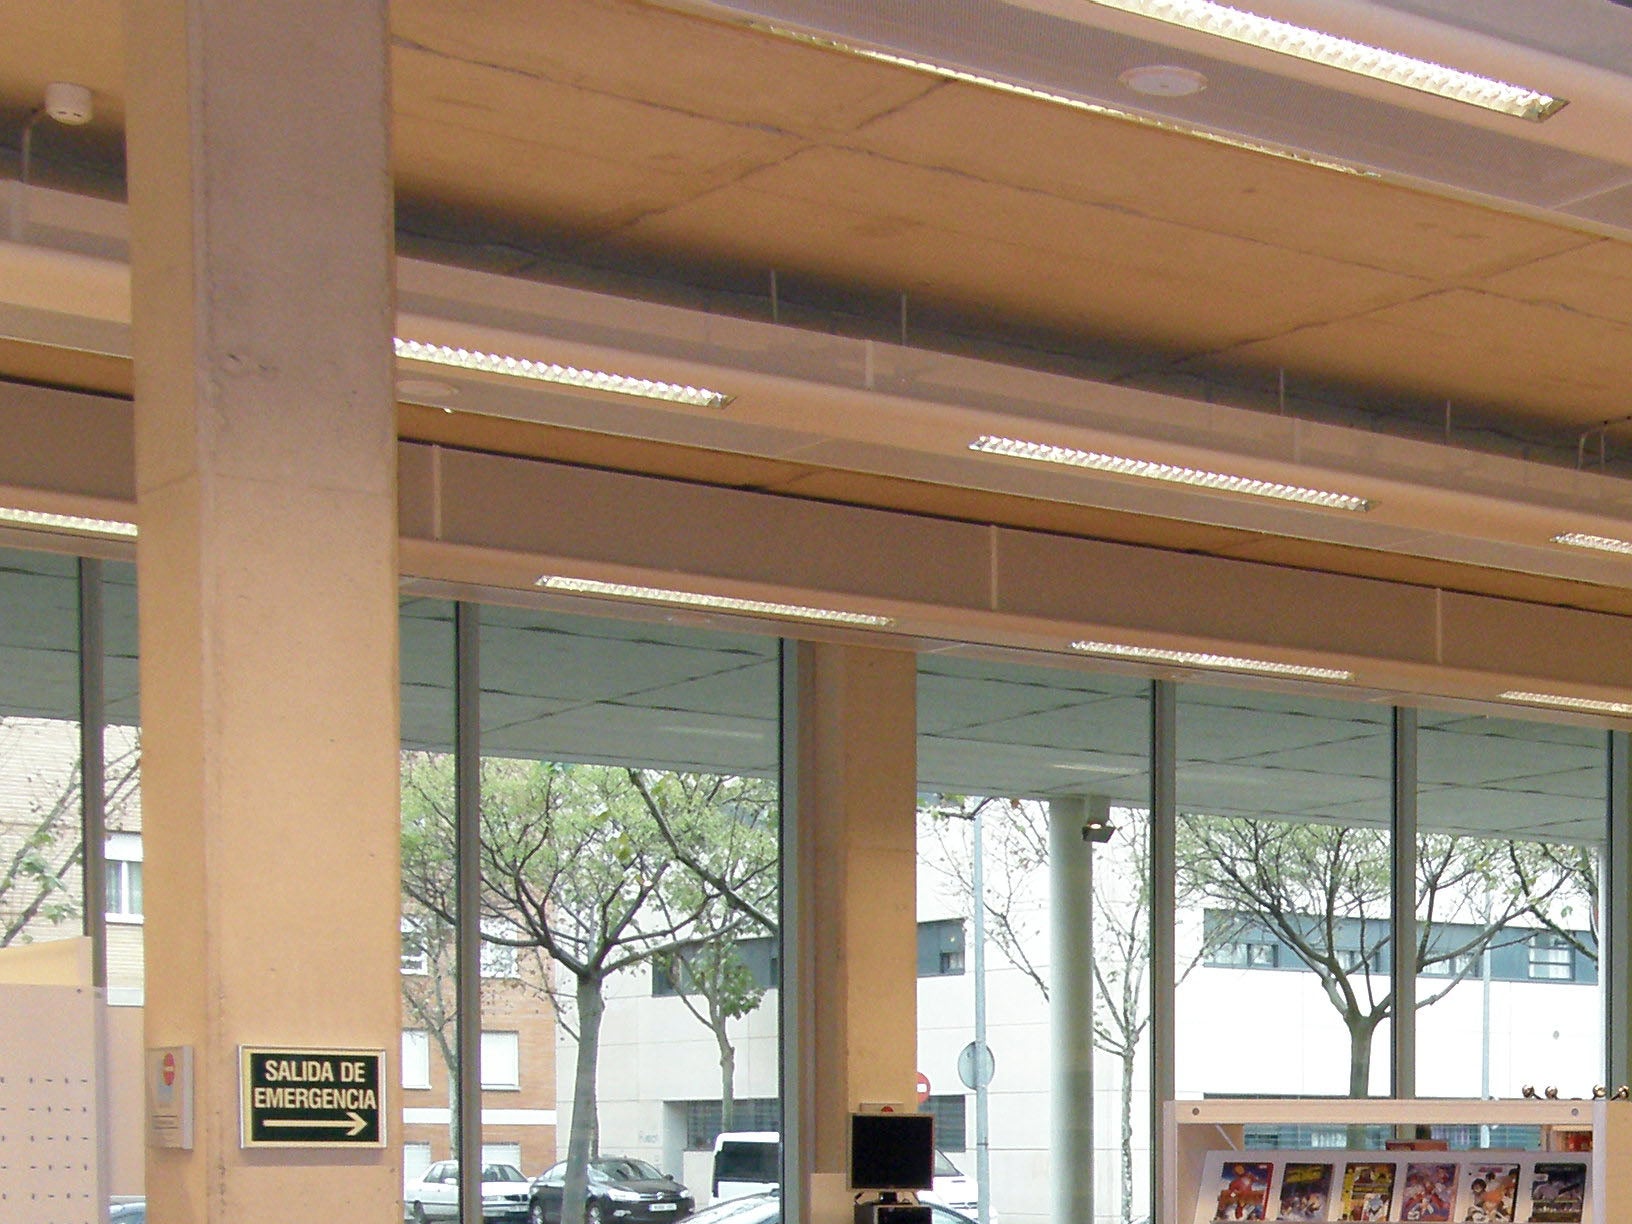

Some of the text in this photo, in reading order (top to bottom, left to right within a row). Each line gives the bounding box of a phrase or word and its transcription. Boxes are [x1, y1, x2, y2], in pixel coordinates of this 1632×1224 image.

[265, 1060, 366, 1082] SALIDA DE
[254, 1087, 378, 1110] EMERGENCIA
